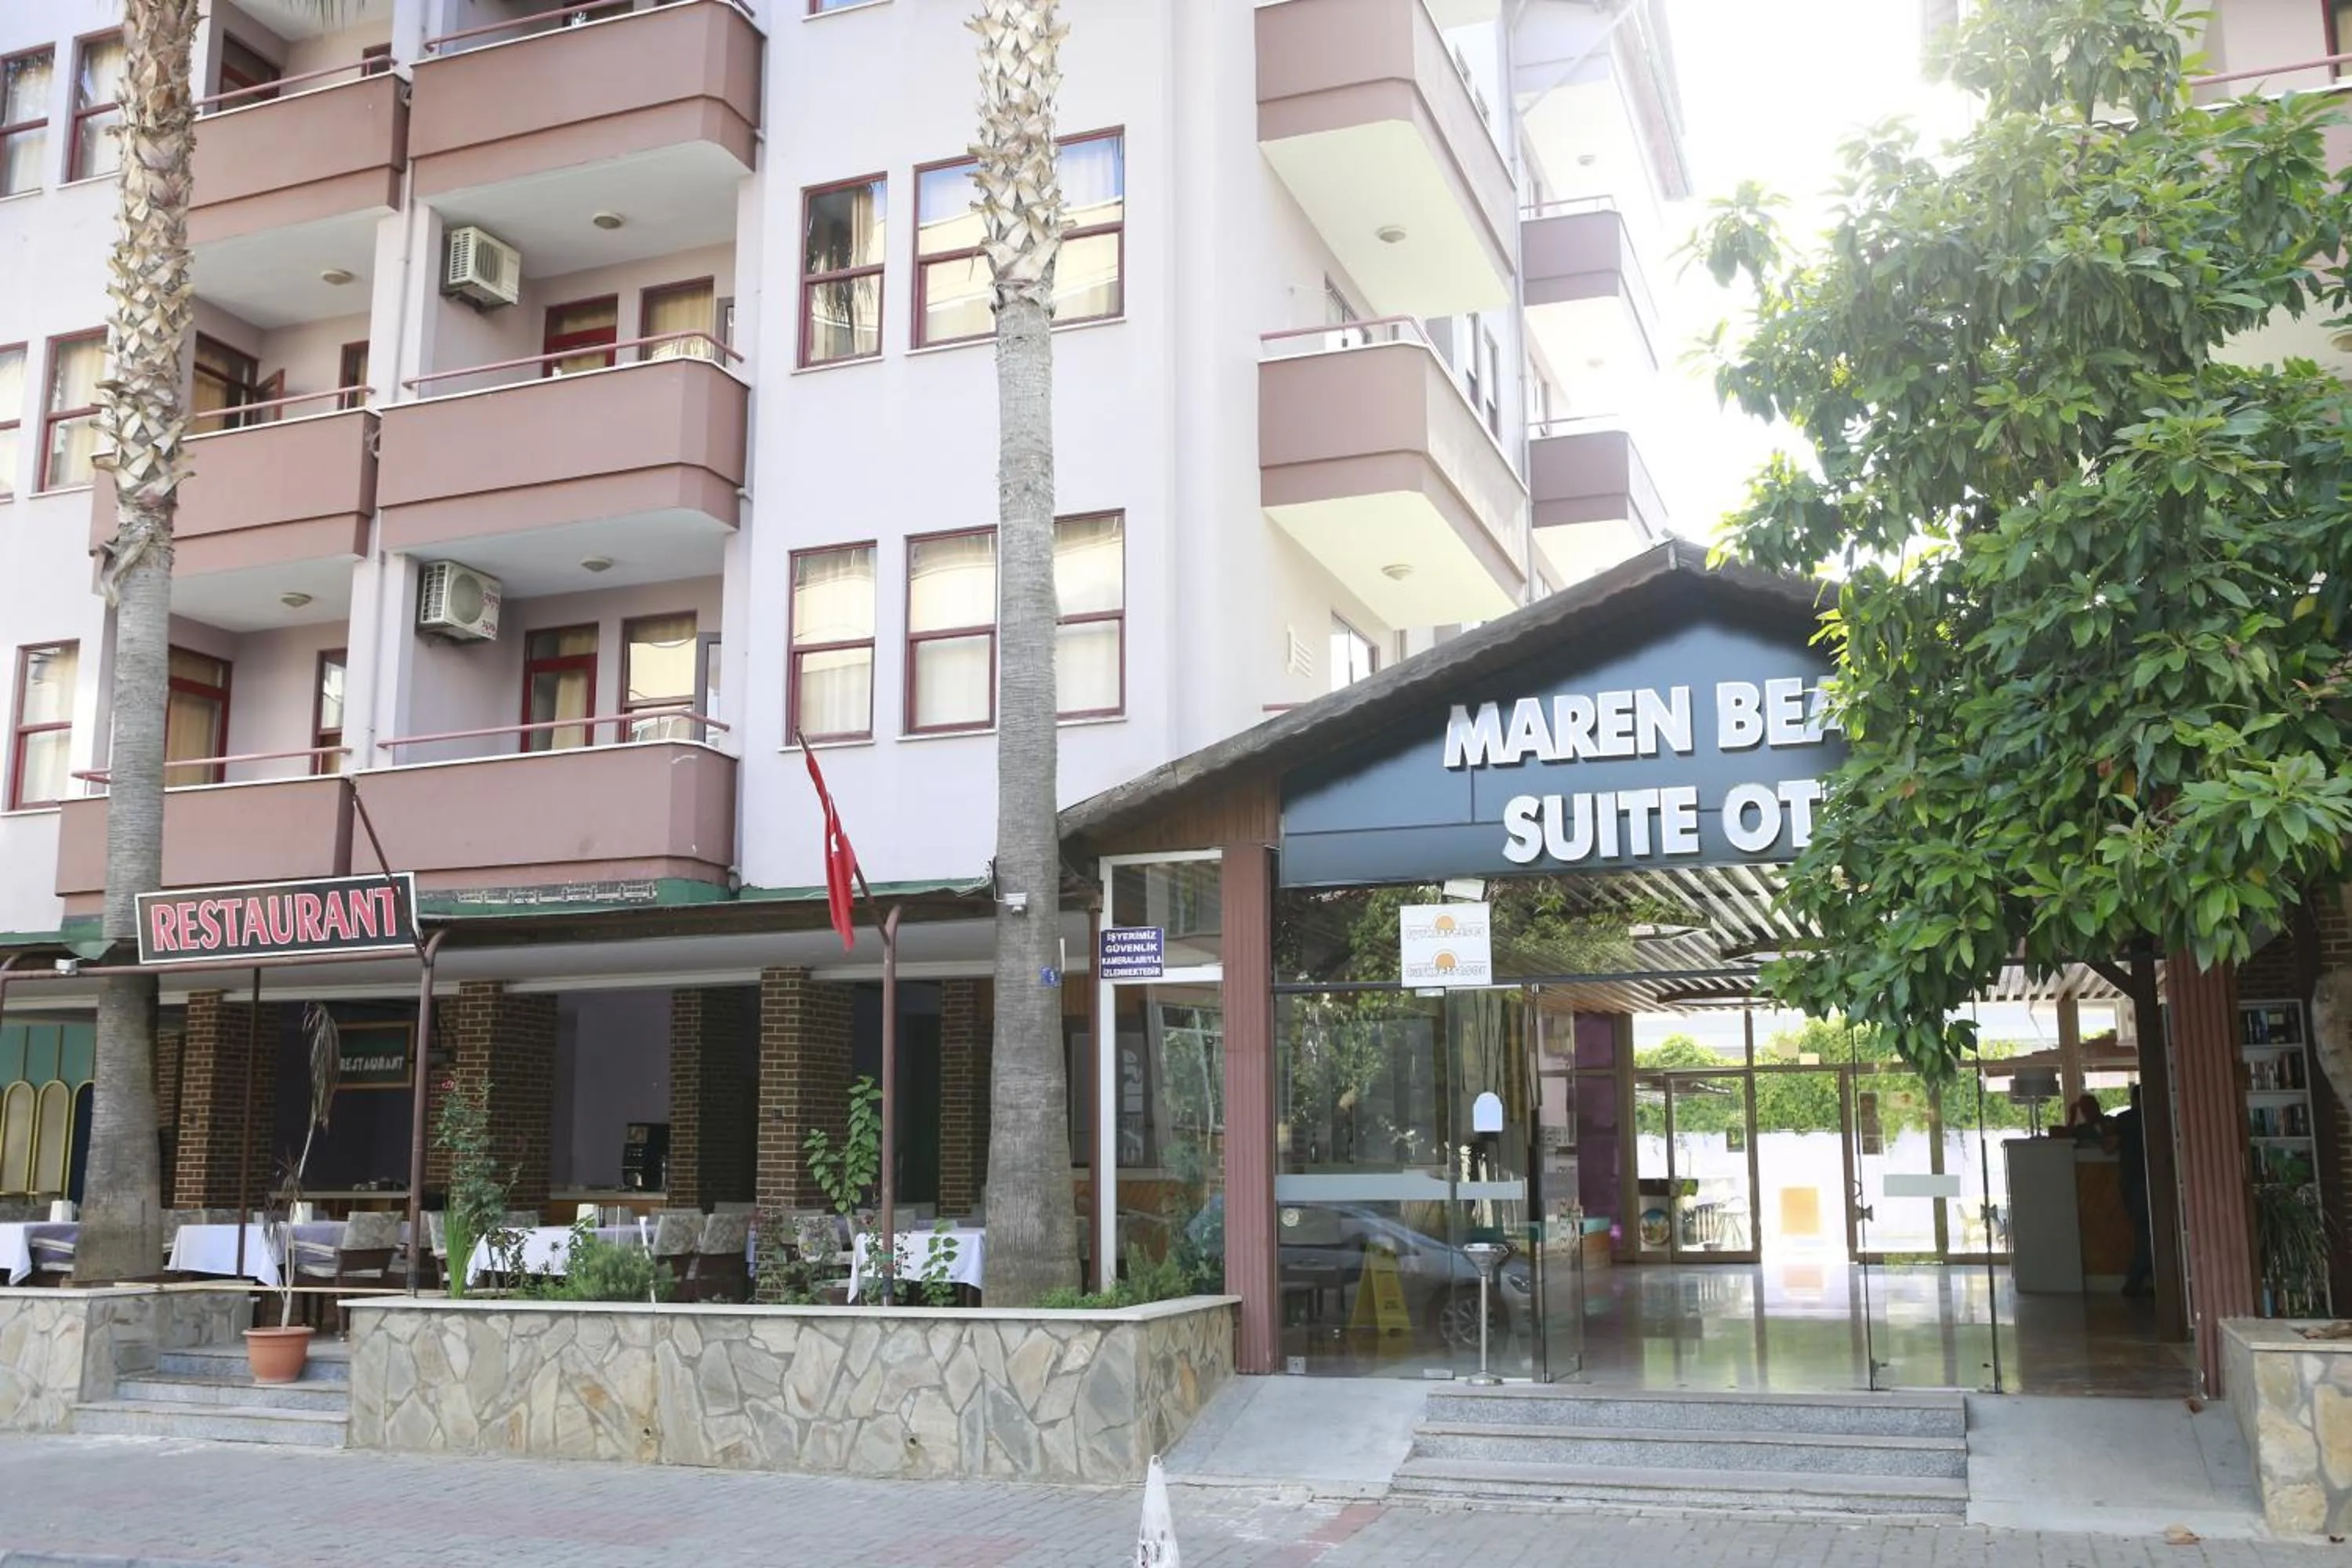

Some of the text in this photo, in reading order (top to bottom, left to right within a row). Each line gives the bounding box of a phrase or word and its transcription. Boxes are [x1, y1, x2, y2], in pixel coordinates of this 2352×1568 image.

[1444, 684, 1693, 769] MAREN
[1502, 779, 1828, 864] SUITE OT
[151, 886, 401, 952] RESTAURANT
[339, 1055, 405, 1073] RESTAURANT
